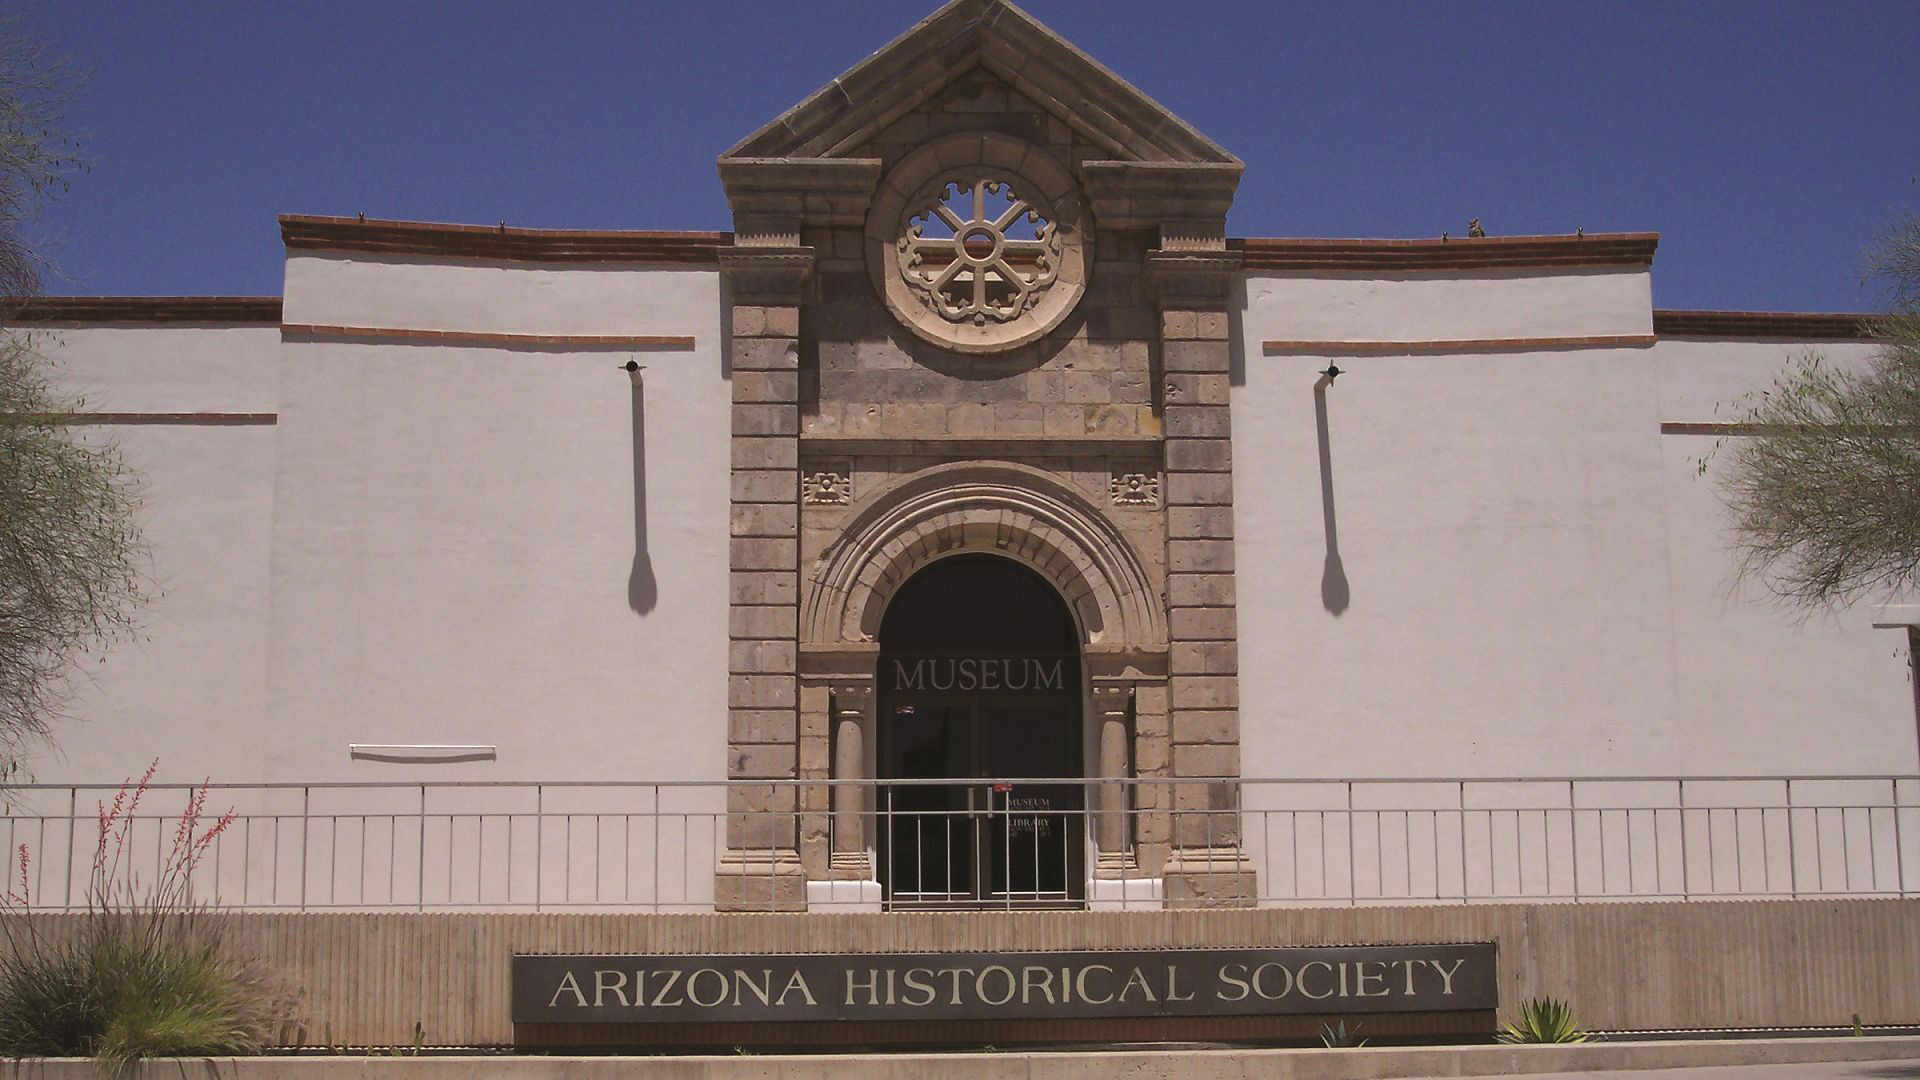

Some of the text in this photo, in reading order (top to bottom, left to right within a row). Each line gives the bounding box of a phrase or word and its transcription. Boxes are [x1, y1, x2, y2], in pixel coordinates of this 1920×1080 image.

[894, 658, 1065, 690] MUSEUM
[1008, 798, 1050, 806] MUSEUM
[549, 958, 1465, 1007] ARIZONA HISTORICAL SOCIETY
